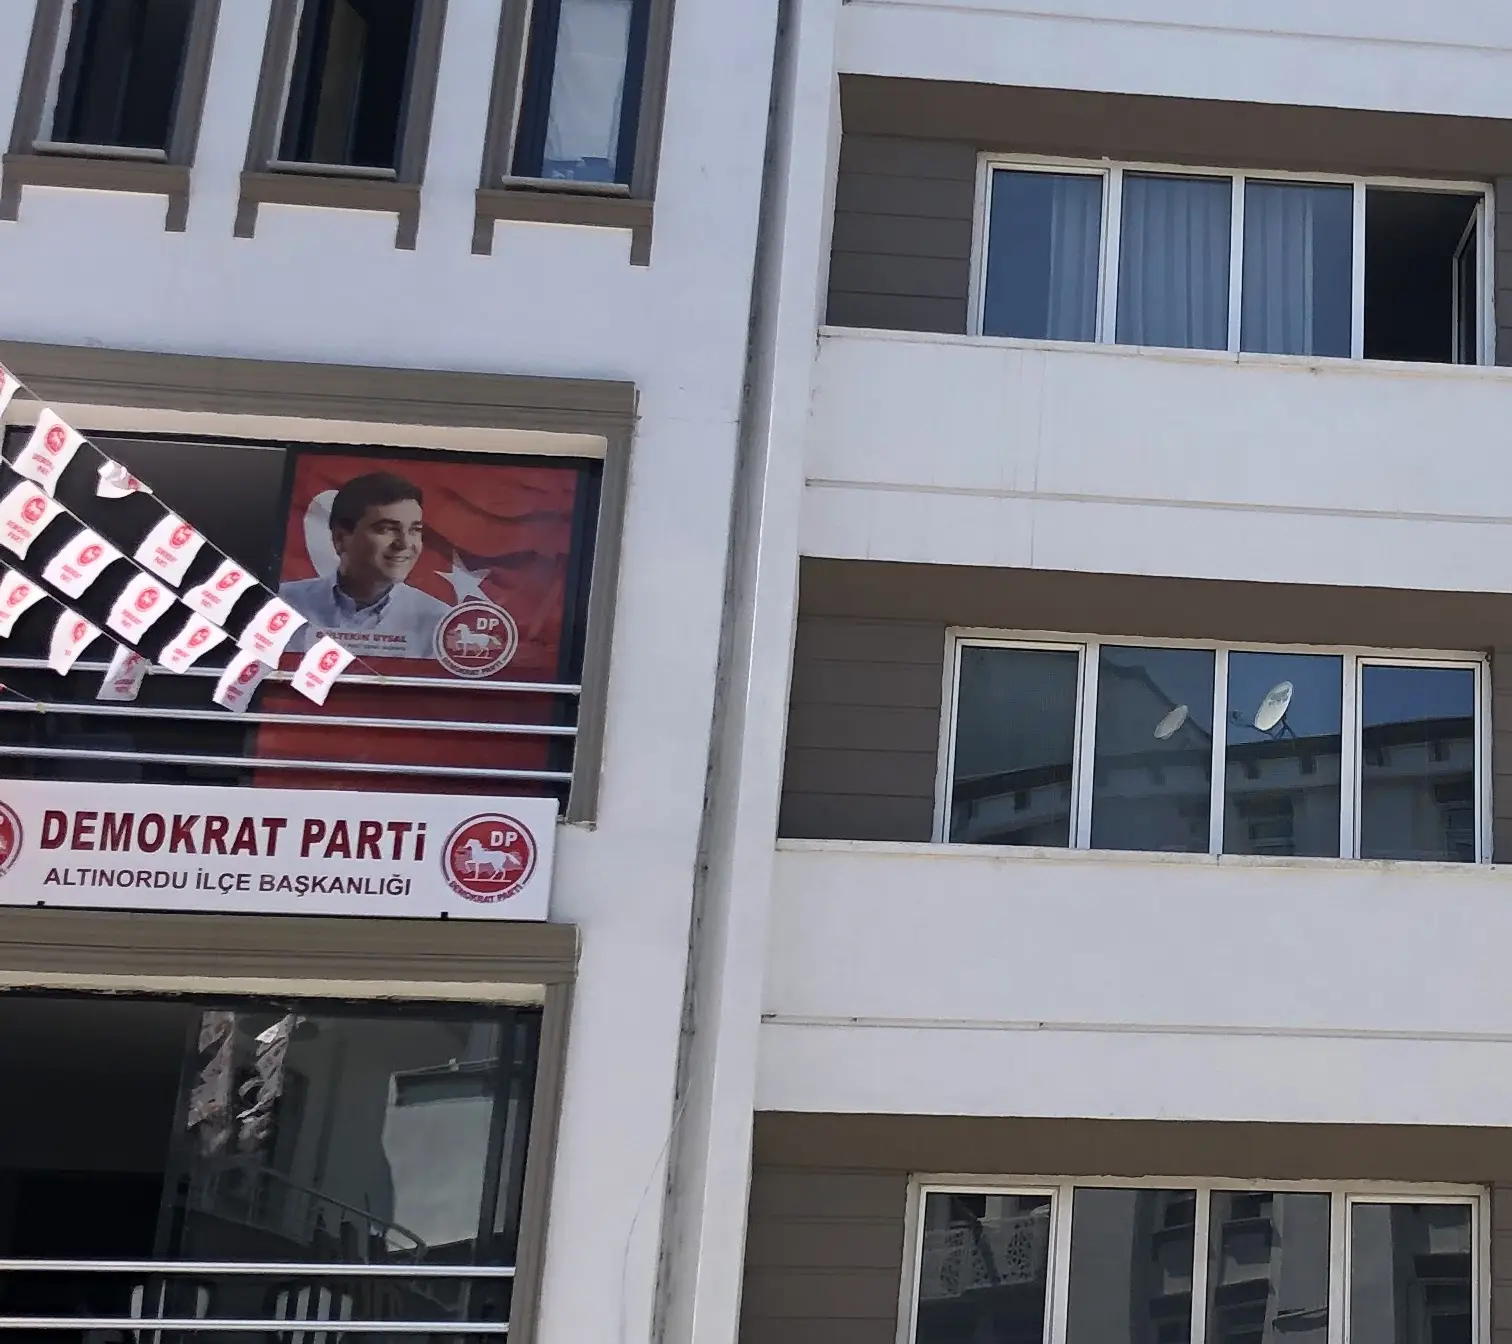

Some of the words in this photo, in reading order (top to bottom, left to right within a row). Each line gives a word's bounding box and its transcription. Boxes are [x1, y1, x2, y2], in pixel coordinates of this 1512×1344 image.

[476, 617, 499, 631] DP
[40, 809, 287, 857] DEMOKRAT
[490, 830, 518, 847] DP
[44, 867, 189, 889] ALTINORDU
[195, 867, 250, 895] İLÇE
[258, 874, 412, 898] BAŞKANLIĞI
